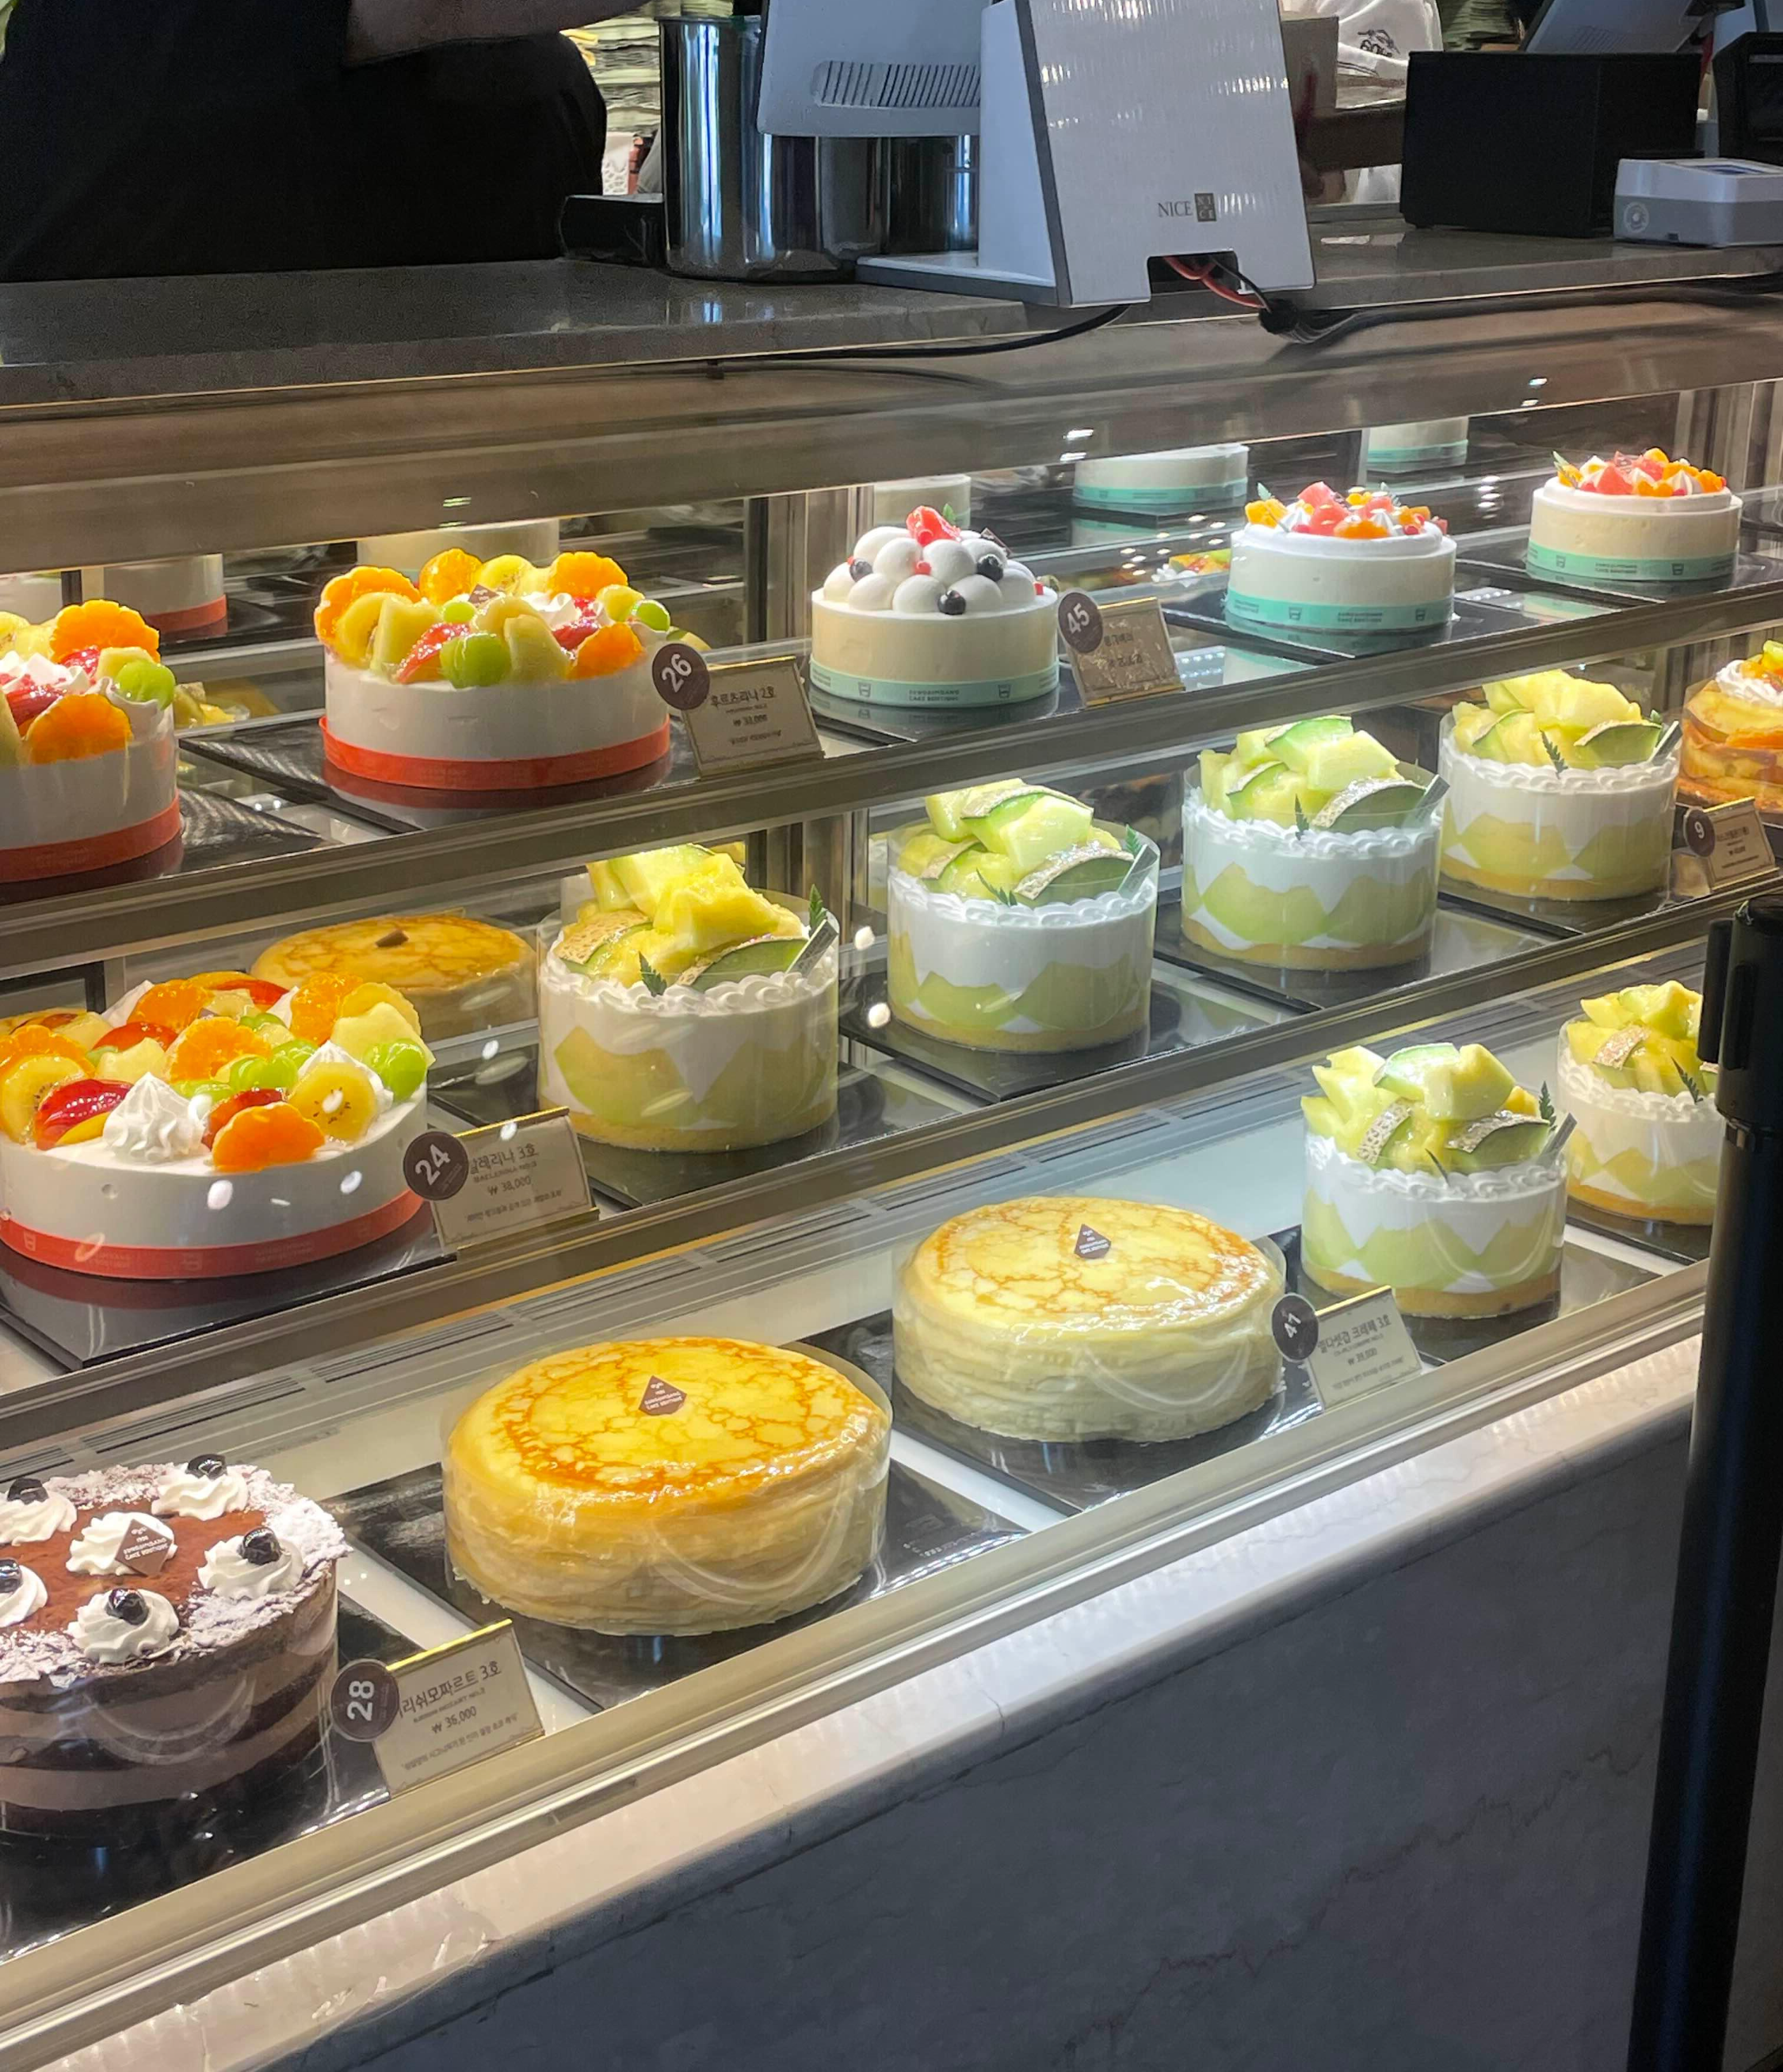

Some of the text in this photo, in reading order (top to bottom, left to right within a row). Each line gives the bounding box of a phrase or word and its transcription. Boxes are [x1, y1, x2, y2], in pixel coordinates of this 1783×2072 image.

[1158, 201, 1193, 218] NICE
[1067, 603, 1090, 634] 45
[661, 654, 692, 693] 26
[1694, 821, 1705, 839] 9
[415, 1144, 451, 1185] 24
[517, 1143, 539, 1160] 3호
[1285, 1313, 1301, 1338] 47
[347, 1680, 375, 1721] 28
[399, 1669, 479, 1718] 리쉬모짜르트
[479, 1661, 502, 1680] 3호
[445, 1706, 477, 1728] 36,000
